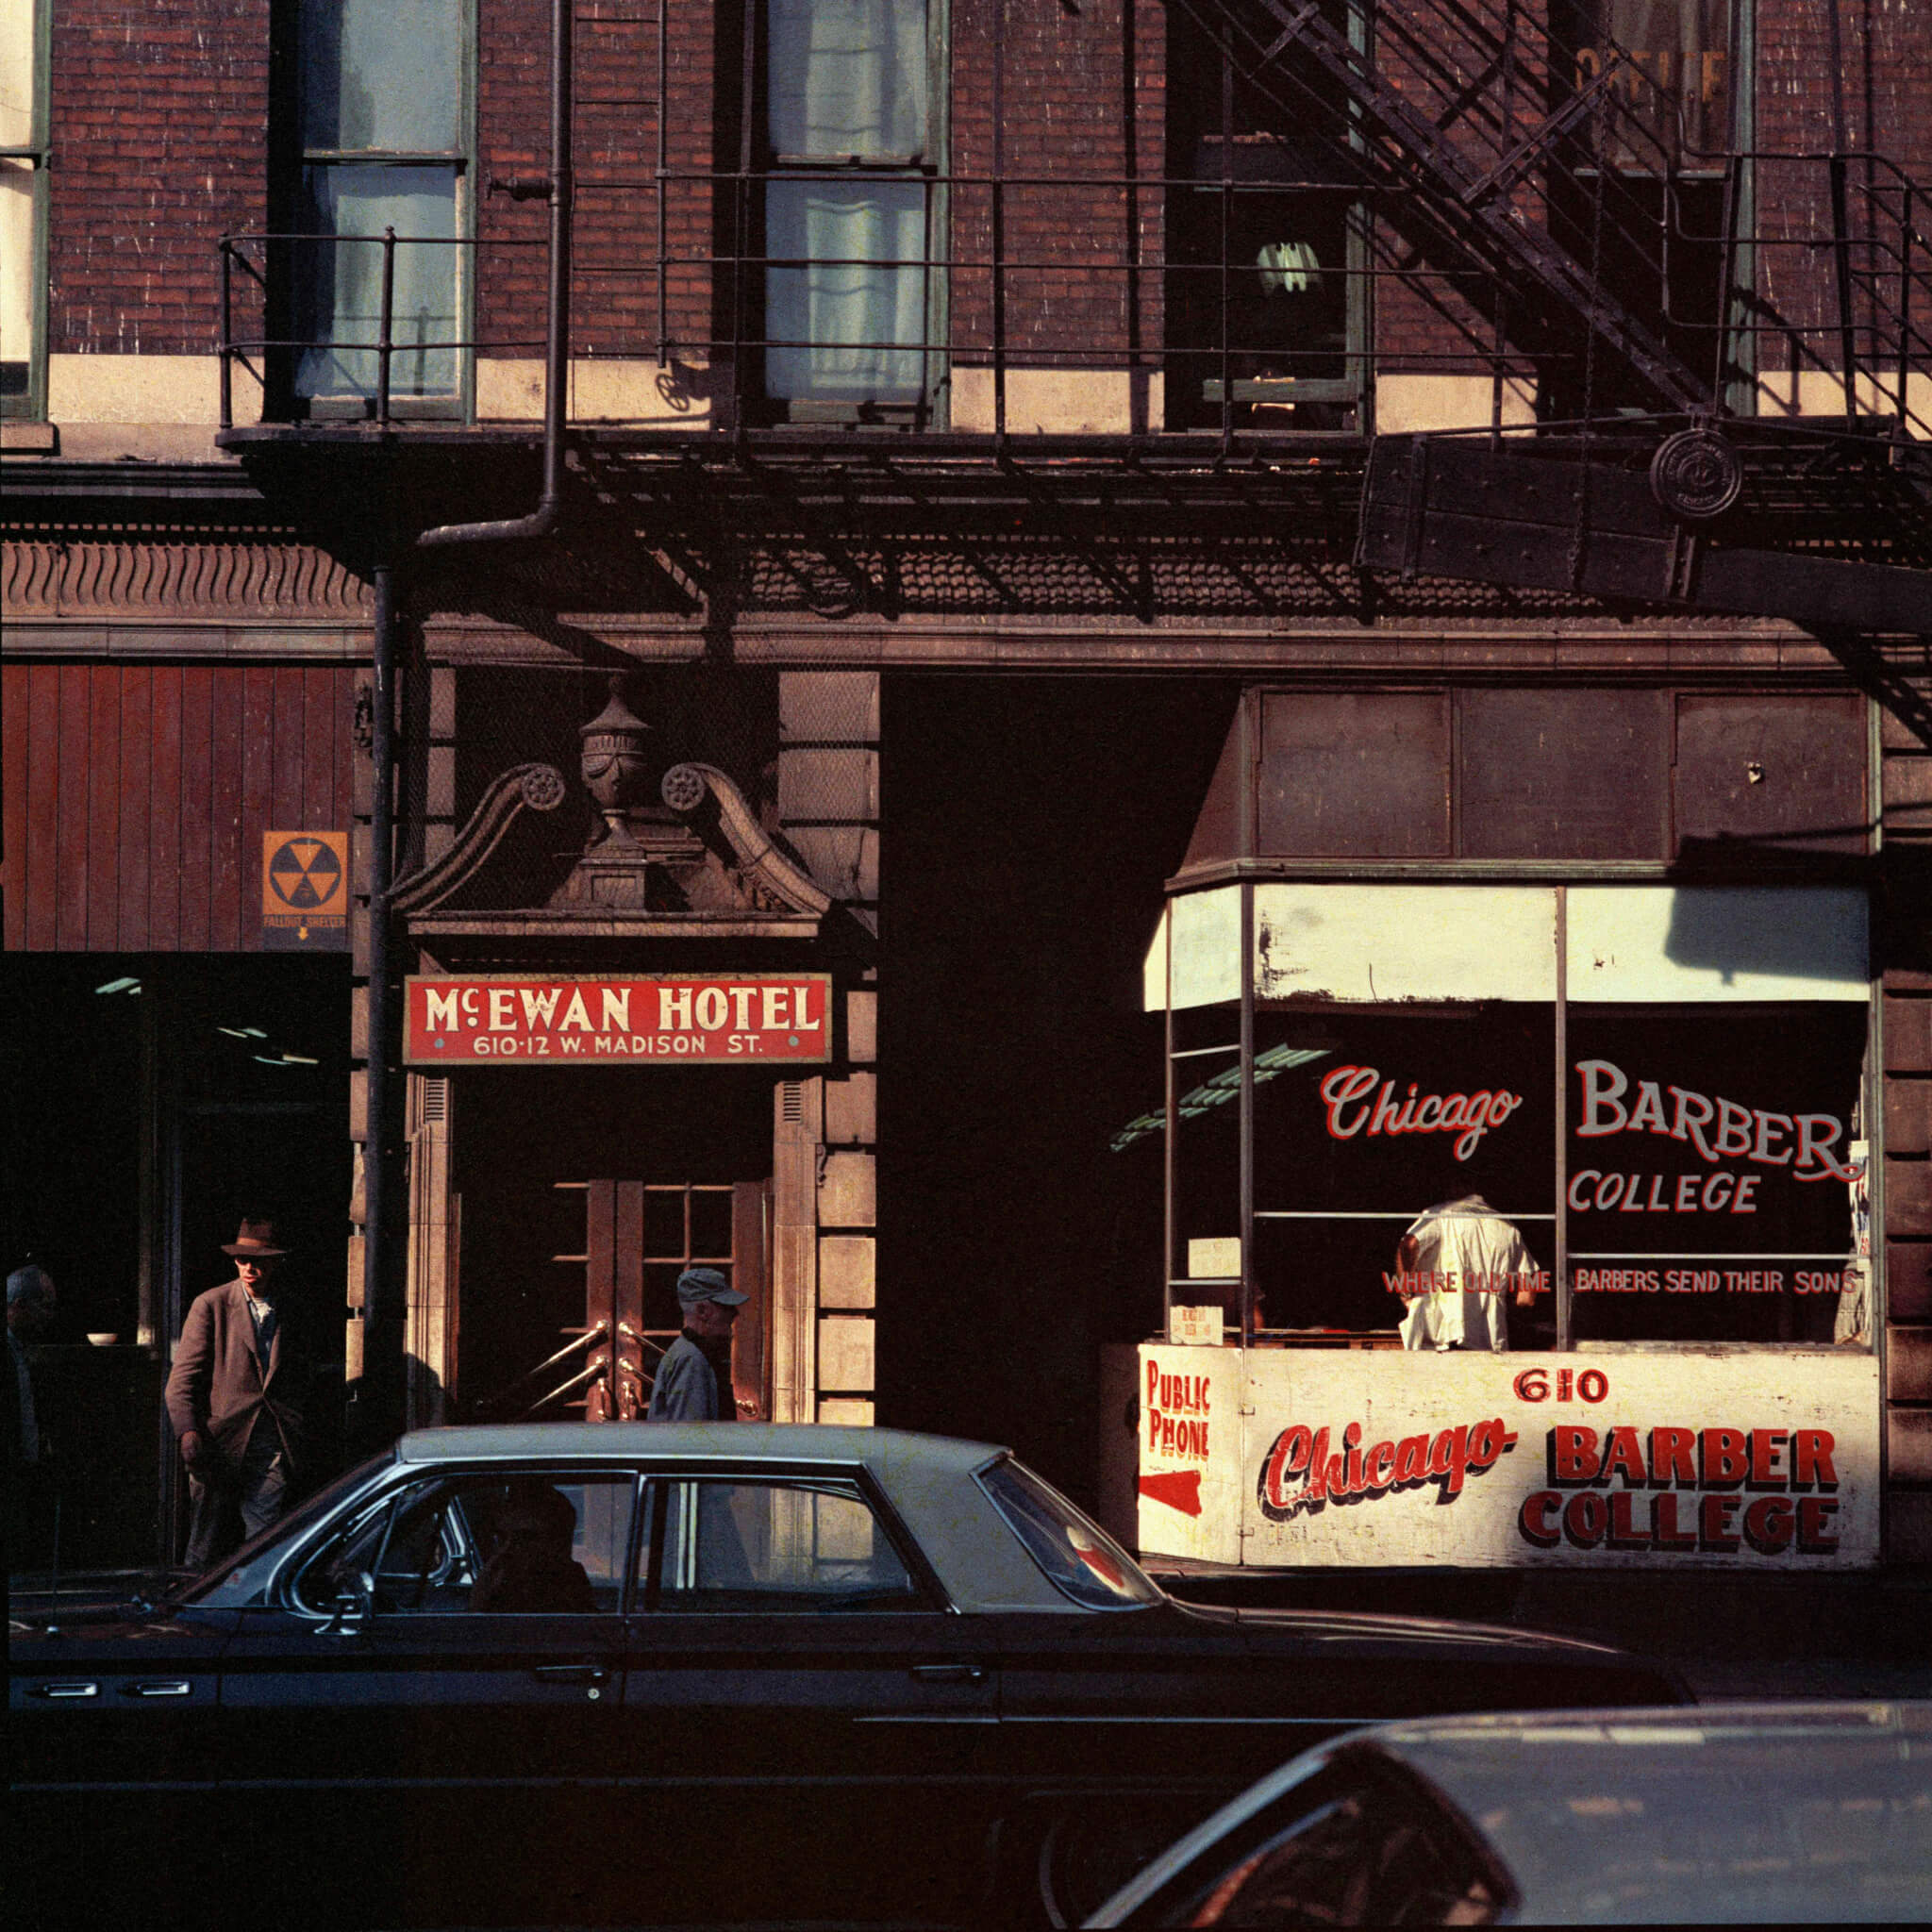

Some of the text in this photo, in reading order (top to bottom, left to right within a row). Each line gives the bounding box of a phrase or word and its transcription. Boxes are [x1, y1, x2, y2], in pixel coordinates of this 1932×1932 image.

[1575, 47, 1726, 102] OFIE
[658, 986, 820, 1032] HOTEL
[559, 1036, 586, 1055] W.
[594, 1035, 706, 1054] MADISON
[726, 1035, 763, 1053] ST.
[1321, 1058, 1866, 1182] Chicago BARBER
[1567, 1169, 1761, 1213] COLLEGE
[1381, 1270, 1857, 1295] WHERE OLD TIME BARBERS SEND THEIR SONS
[1146, 1359, 1210, 1416] PUBLIC
[1512, 1368, 1608, 1404] 610
[1148, 1408, 1209, 1461] PHONE
[1257, 1417, 1840, 1523] Chicago BARBER
[1517, 1491, 1840, 1554] COLLEGE
